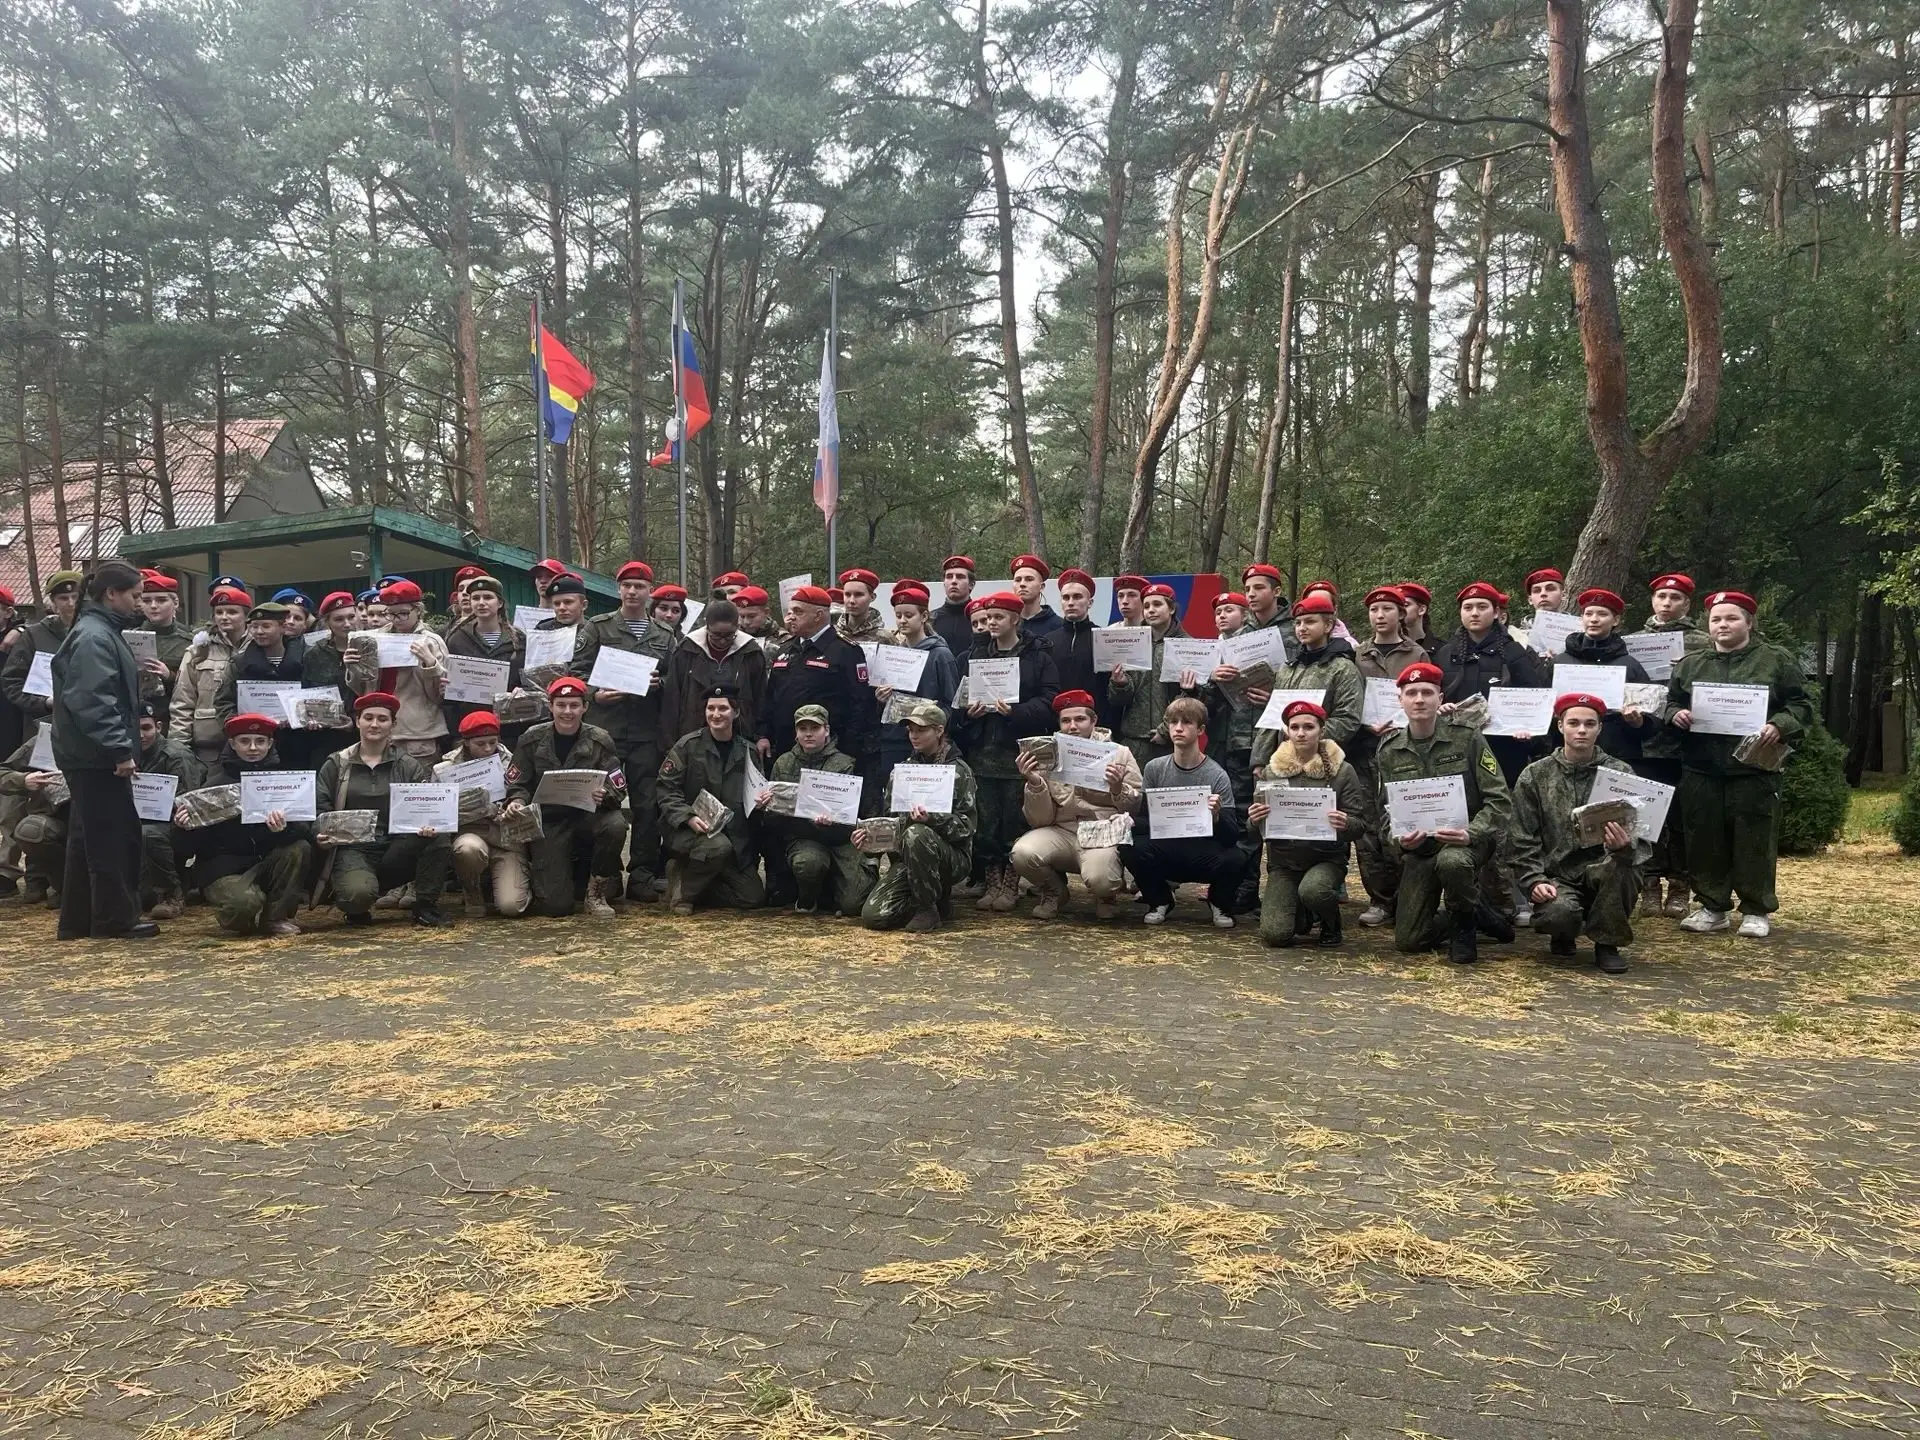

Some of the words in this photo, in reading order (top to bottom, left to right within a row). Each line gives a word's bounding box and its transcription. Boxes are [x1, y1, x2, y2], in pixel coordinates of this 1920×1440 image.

[1234, 640, 1270, 654] СЕРТИФИКАТ
[460, 668, 497, 677] СЕРТИФИКАТ
[454, 769, 491, 783] СЕРТИФИКАТ
[132, 784, 163, 792] ТИФИКАТ
[812, 784, 850, 792] СЕРТИФИКАТ
[1404, 792, 1449, 801] СЕРТИФИКАТ
